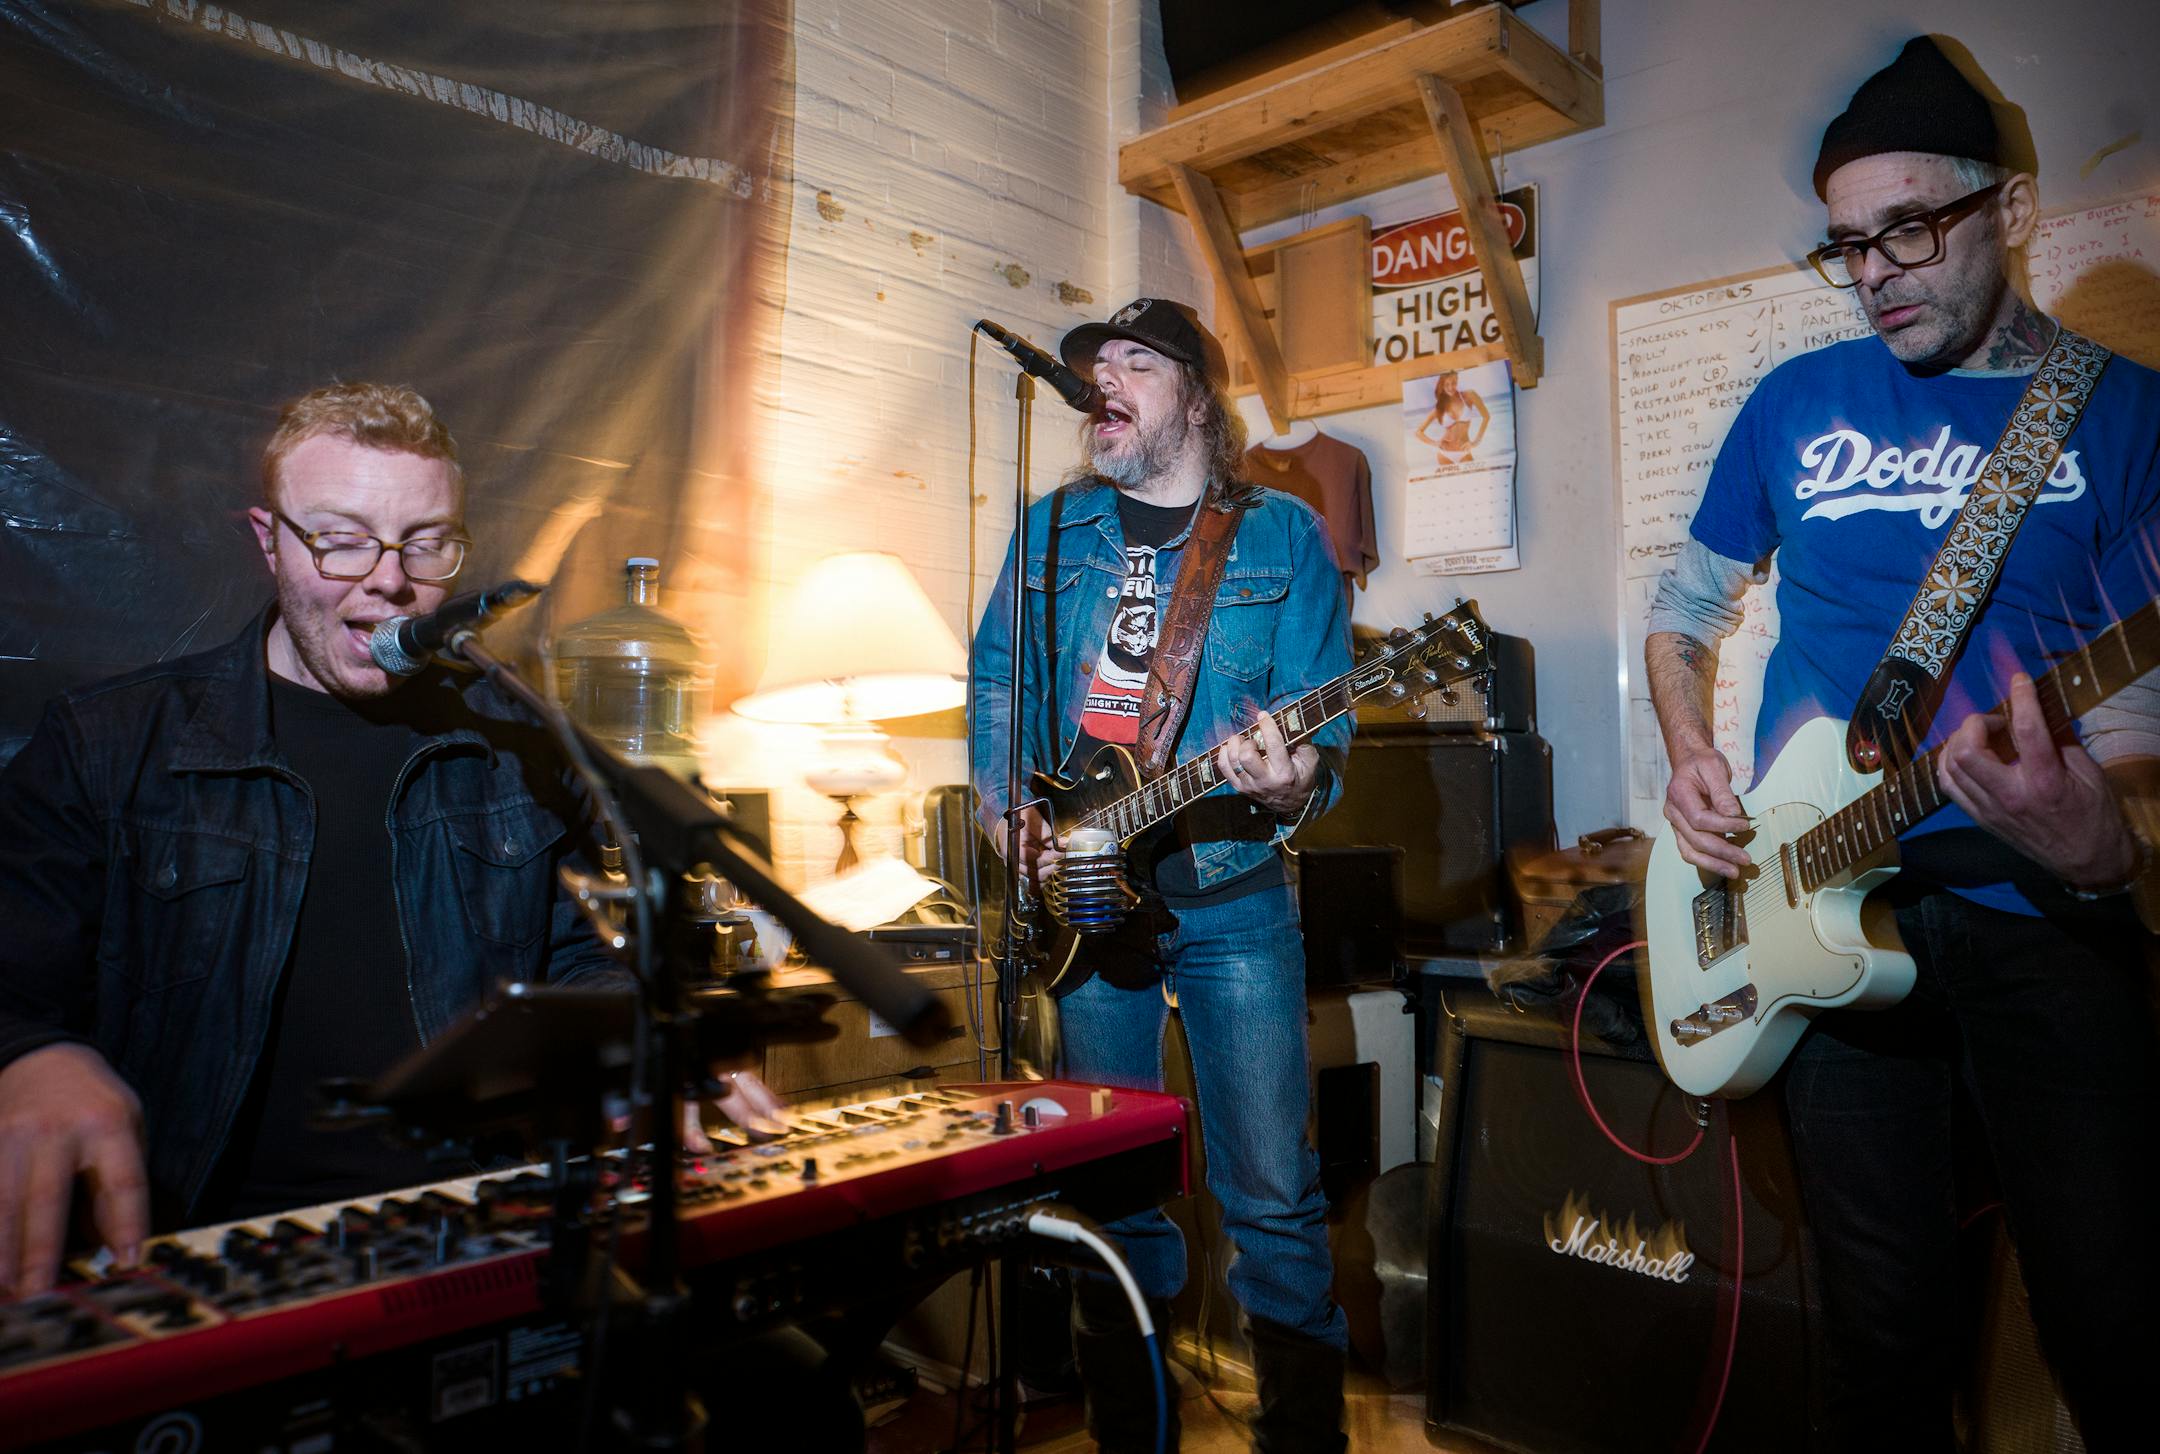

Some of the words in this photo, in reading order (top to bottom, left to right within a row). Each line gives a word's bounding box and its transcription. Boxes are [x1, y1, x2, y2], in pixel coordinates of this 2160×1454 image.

[1373, 213, 1512, 278] DANG
[2068, 248, 2142, 270] VICTORIA
[1397, 278, 1488, 327] HIGH
[1801, 307, 1868, 330] PANTHE
[1373, 313, 1501, 363] OLTAG
[1804, 327, 1874, 349] INBETWE
[1795, 425, 2086, 529] Dodgs
[1456, 618, 1485, 655] Gibson
[1354, 670, 1386, 691] Standard
[1551, 1215, 1695, 1284] Marshall
